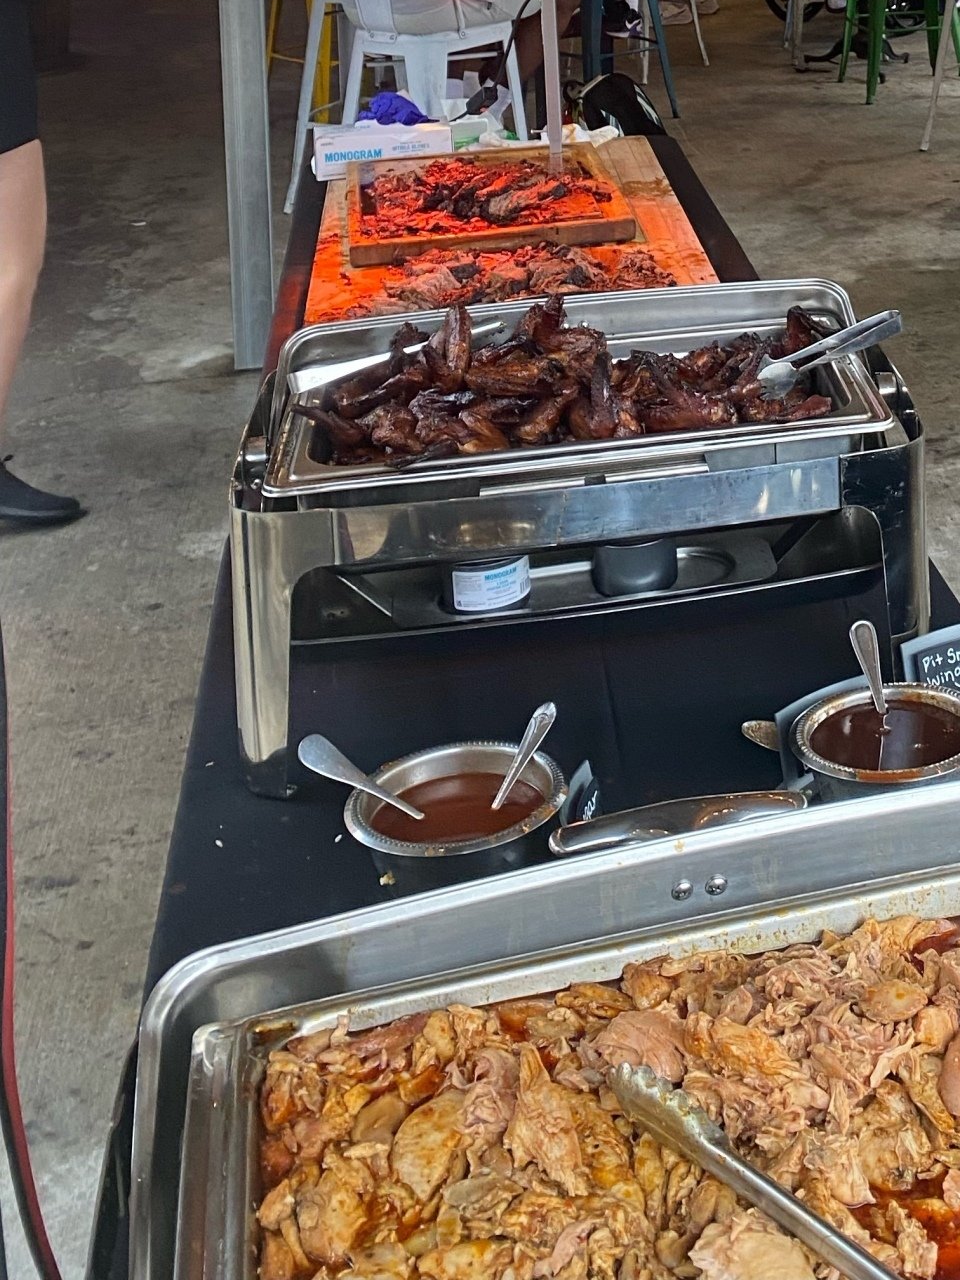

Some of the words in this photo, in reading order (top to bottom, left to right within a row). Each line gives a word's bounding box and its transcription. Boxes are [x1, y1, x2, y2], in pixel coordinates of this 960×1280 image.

[324, 148, 383, 163] MONOGRAM
[484, 566, 518, 581] MONOGRAM
[922, 653, 944, 673] Pit
